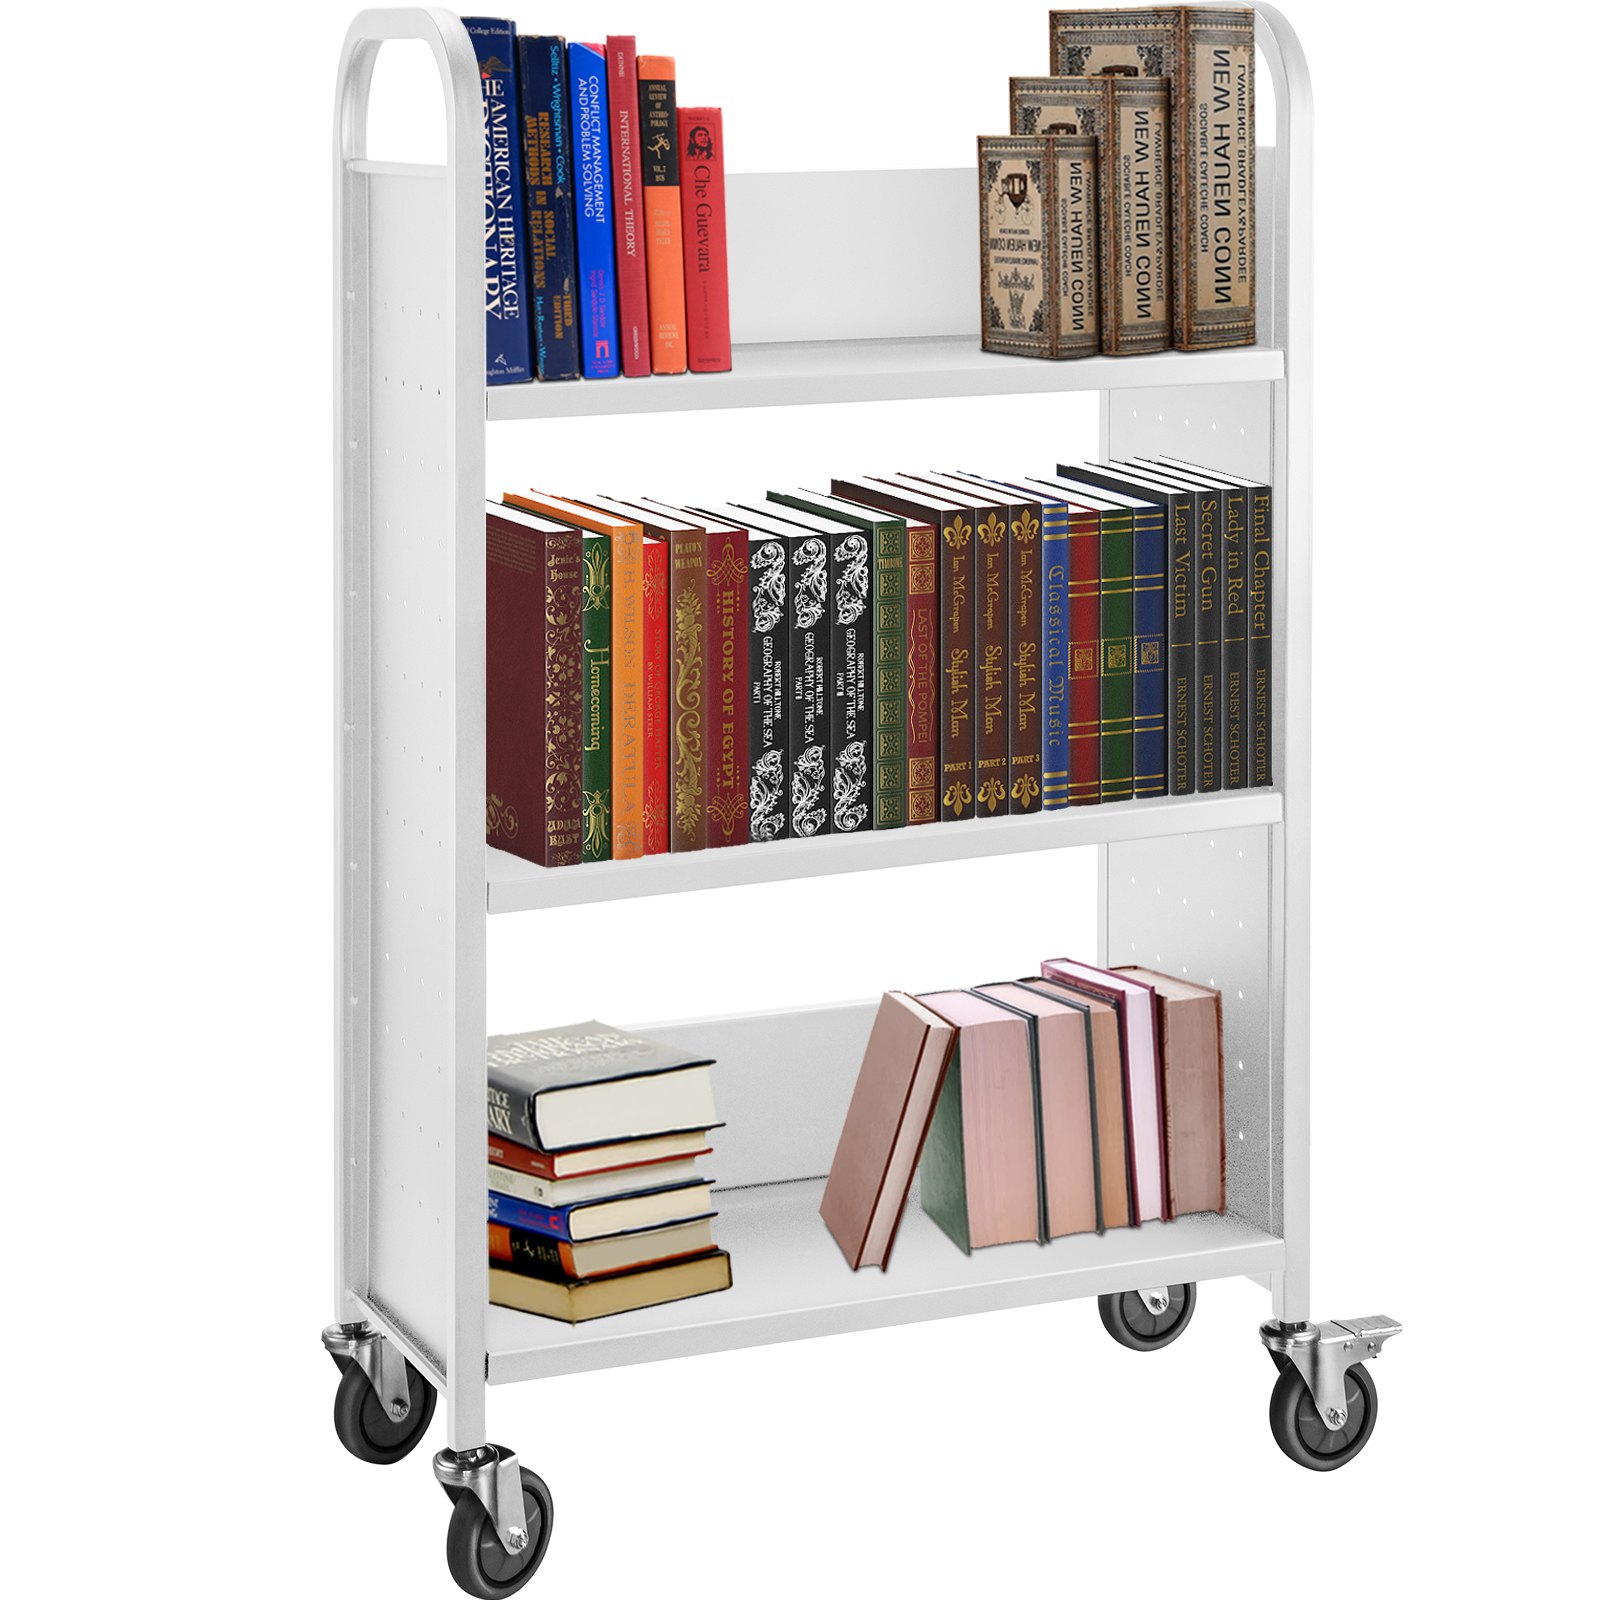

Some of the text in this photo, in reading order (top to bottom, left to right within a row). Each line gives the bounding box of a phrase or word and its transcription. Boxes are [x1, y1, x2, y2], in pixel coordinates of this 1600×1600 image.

[469, 26, 511, 36] College Edition
[550, 83, 562, 147] Wrightsman
[648, 84, 668, 92] ANNUAL
[648, 93, 667, 101] REVIEW
[525, 115, 540, 186] METHODS
[538, 112, 552, 186] RESEARCH
[555, 155, 565, 184] Cook
[577, 77, 595, 218] AND PROBLEM SOLVING
[588, 76, 605, 223] CONFLICT MANAGEMENT
[619, 110, 637, 258] INTERNATIONAL THEORY
[490, 98, 520, 320] AMERICAN HERITAGE
[535, 190, 547, 205] IN
[543, 210, 556, 257] SOCIAL
[694, 165, 713, 273] Che Guevara
[531, 210, 545, 288] RELATIONS
[553, 295, 563, 339] EDITION
[563, 294, 572, 326] THIRD
[549, 568, 578, 583] House
[674, 556, 703, 569] WEAPON
[953, 555, 965, 573] Ian
[987, 552, 999, 569] Ian
[1020, 549, 1033, 566] Ian
[1174, 503, 1191, 618] Last Victim
[1201, 499, 1217, 612] Secret Gun
[1224, 496, 1244, 616] Lady in Red
[1250, 495, 1270, 631] Final Chapter
[624, 594, 636, 668] WILSON
[647, 661, 653, 671] BY
[857, 652, 865, 679] ROBERT
[1048, 565, 1065, 747] Classical Music
[584, 639, 609, 751] Homecoming
[722, 590, 735, 789] HISTORY OF EGYPT
[753, 681, 761, 700] PART
[762, 635, 773, 748] GEOGRAPHY OF THE SEA
[774, 660, 782, 688] ROBERT
[794, 676, 803, 695] PART
[804, 631, 815, 744] GEOGRAPHY OF THE SEA
[815, 656, 824, 684] ROBERT
[836, 672, 844, 691] PART
[845, 628, 856, 740] GEOGRAPHY OF THE SEA
[917, 608, 929, 743] LAST OF THE POMPEI
[945, 648, 969, 738] Stylish Man
[979, 644, 1003, 735] Stylish Man
[1013, 641, 1037, 731] Stylish Man
[1011, 753, 1040, 765] PART 3
[1176, 677, 1188, 791] ERNEST SCHOTER
[1203, 674, 1214, 788] ERNEST SCHOTER
[1229, 671, 1240, 785] ERNEST SCHOTER
[1256, 668, 1266, 782] ERNEST SCHOTER
[944, 760, 972, 773] PART 1
[978, 757, 1007, 769] PART 2
